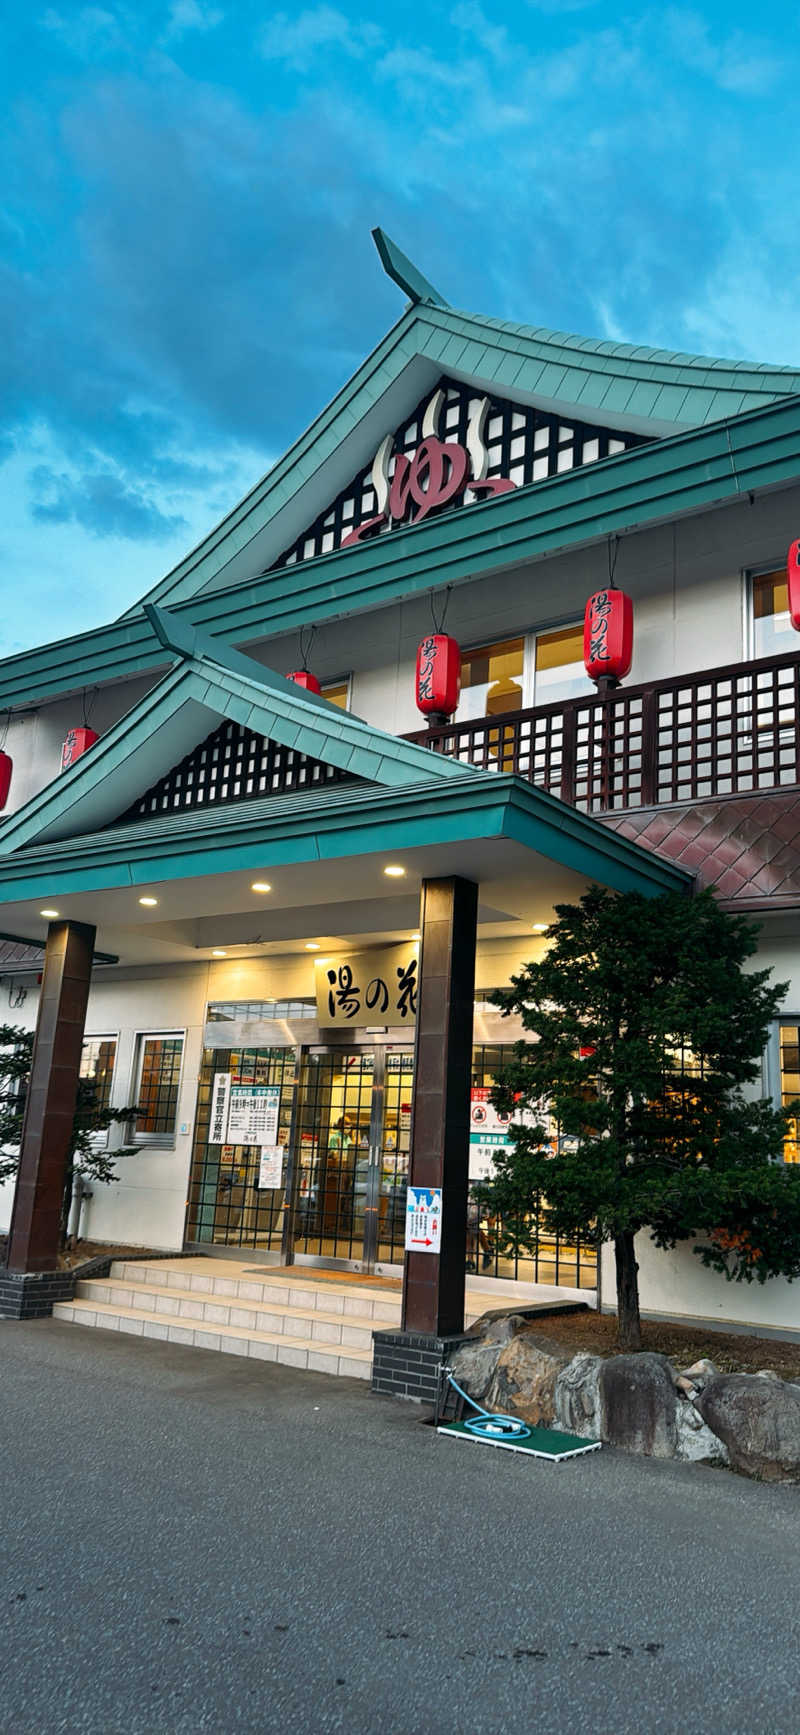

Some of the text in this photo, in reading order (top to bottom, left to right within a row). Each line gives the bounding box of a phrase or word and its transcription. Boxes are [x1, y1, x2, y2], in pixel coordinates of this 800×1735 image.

[389, 436, 468, 523] ゆ
[590, 592, 612, 662] 湯の花
[419, 639, 438, 701] 湯の花
[212, 1087, 226, 1141] 警察官立寄所
